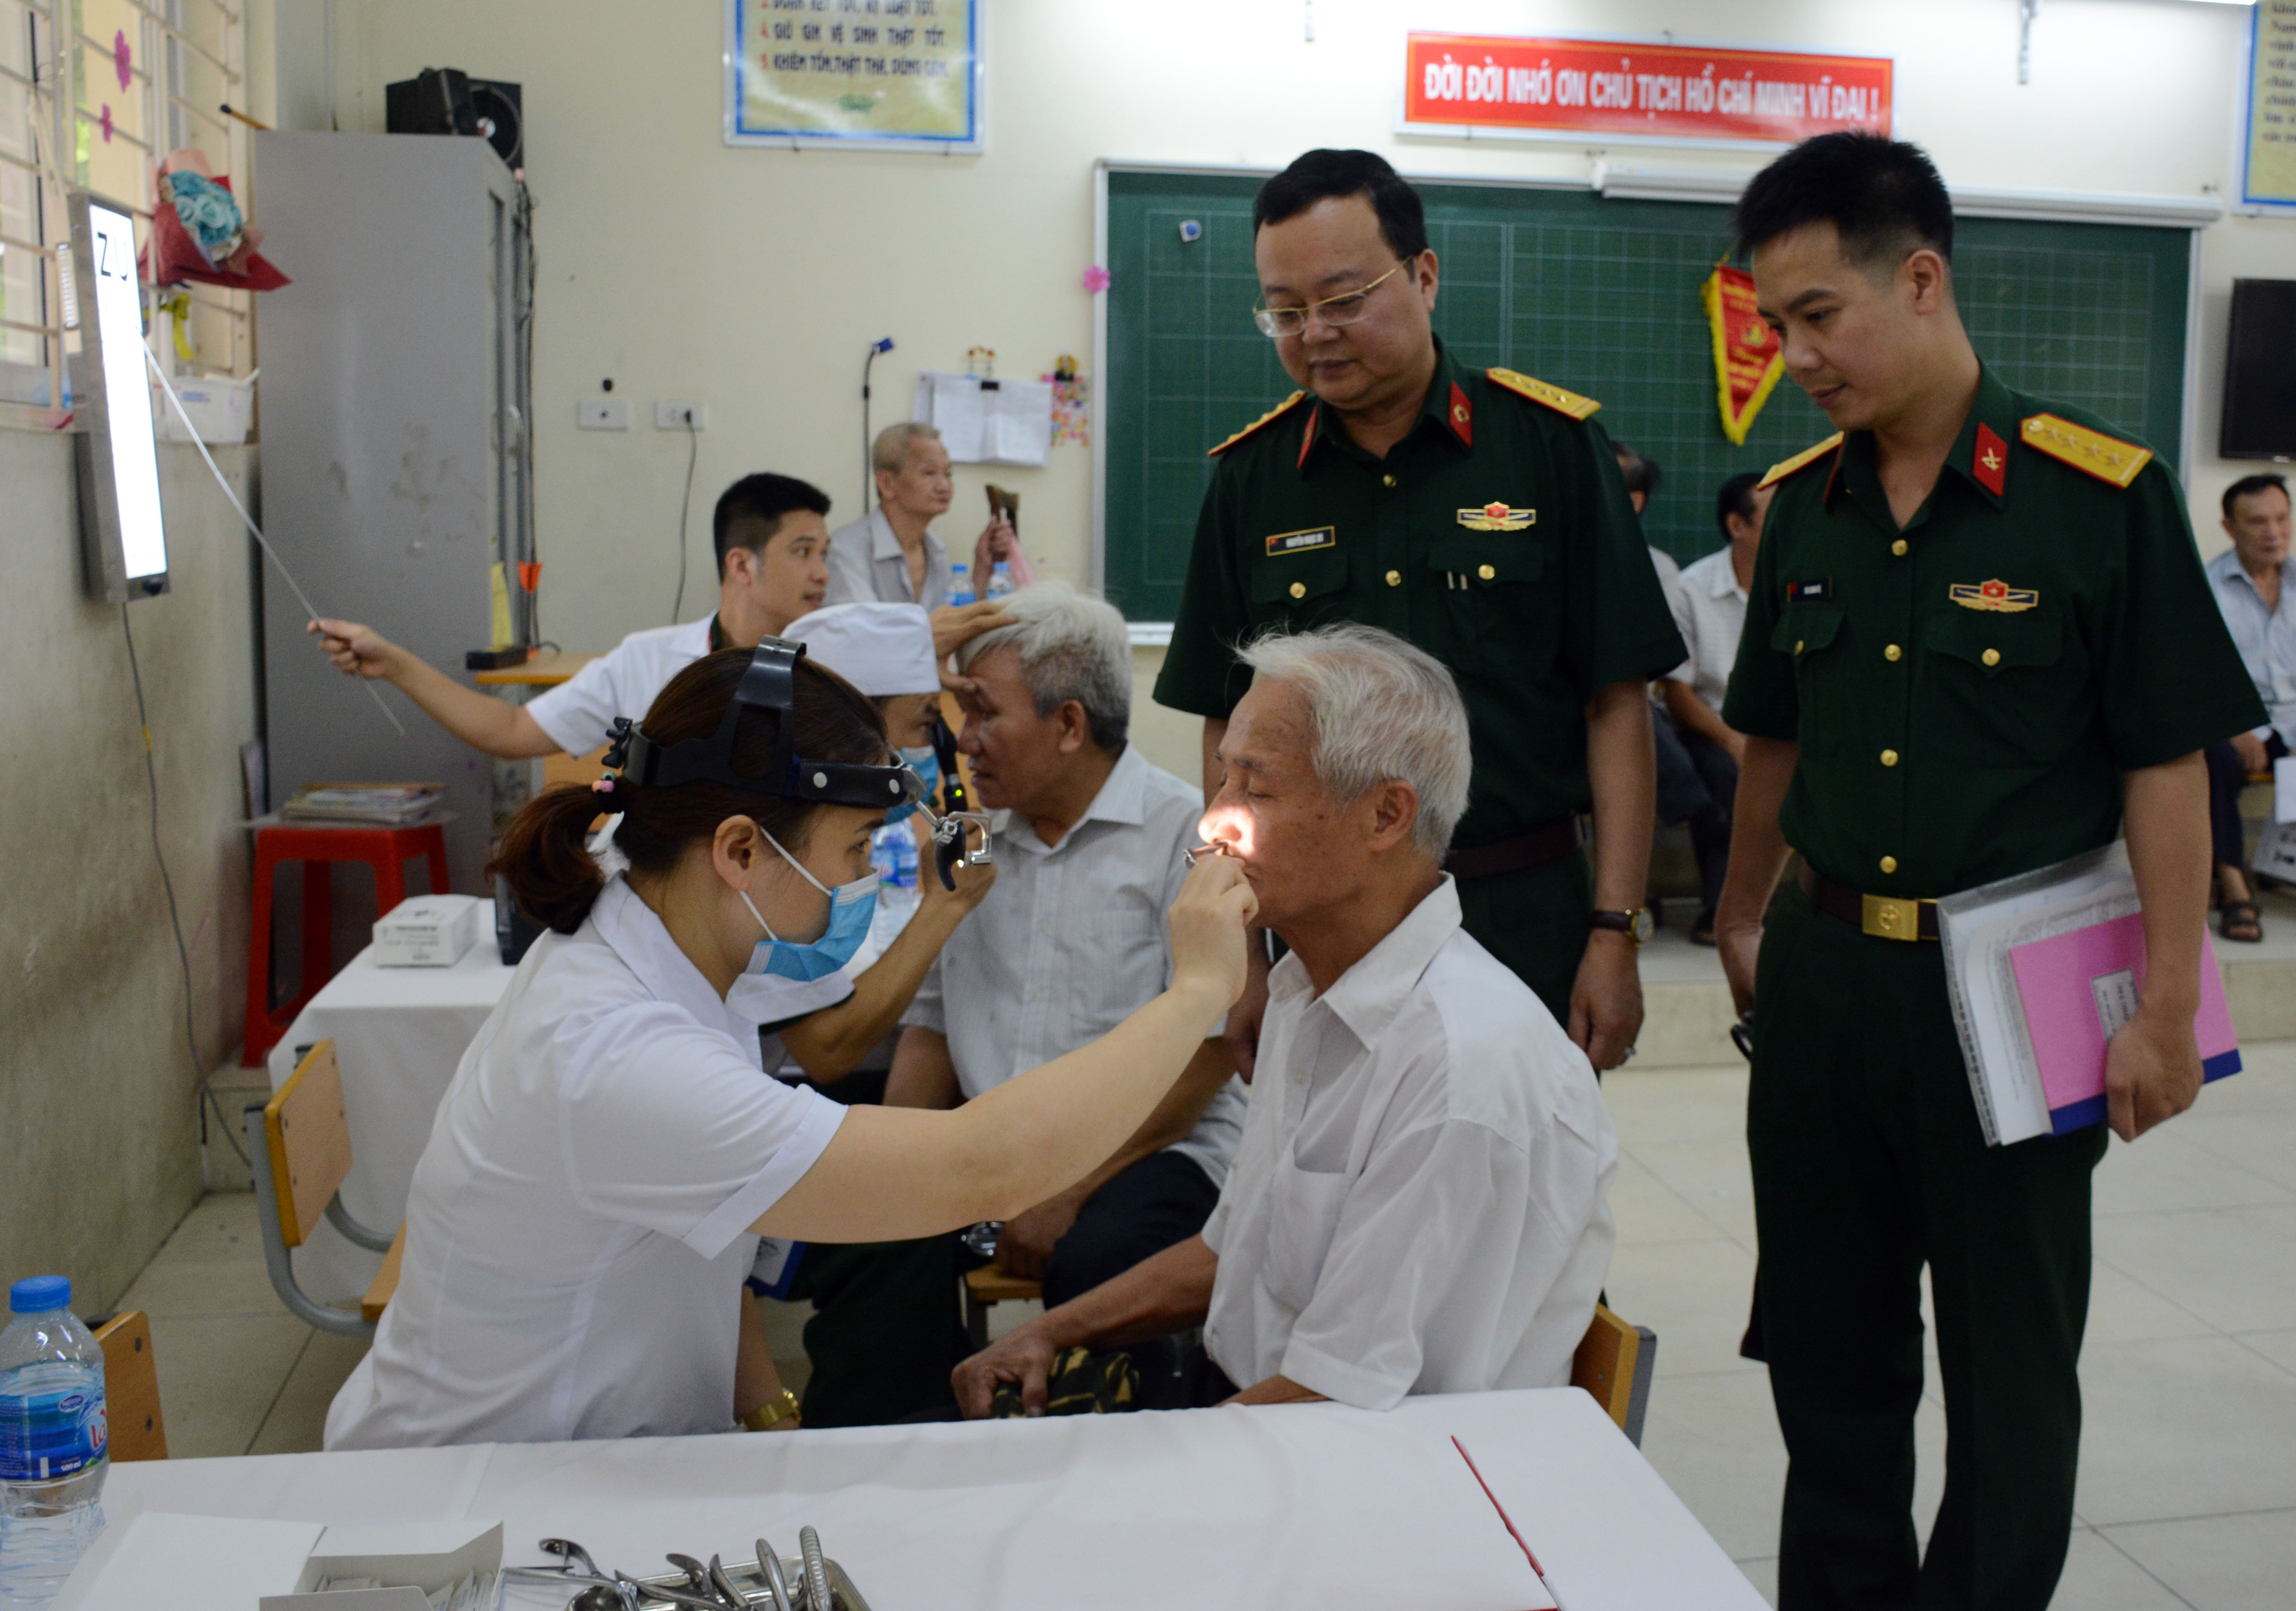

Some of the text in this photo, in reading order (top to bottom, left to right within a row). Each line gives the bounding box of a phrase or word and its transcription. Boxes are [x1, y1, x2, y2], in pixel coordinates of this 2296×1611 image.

[1424, 53, 1463, 101] ĐỜI
[1465, 55, 1504, 103] ĐỜI
[1507, 58, 1553, 105] NHỚ
[1589, 57, 1633, 109] CHỦ
[1636, 73, 1682, 121] TỊCH
[1717, 70, 1753, 115] CHÍ
[1754, 80, 1806, 118] MINH
